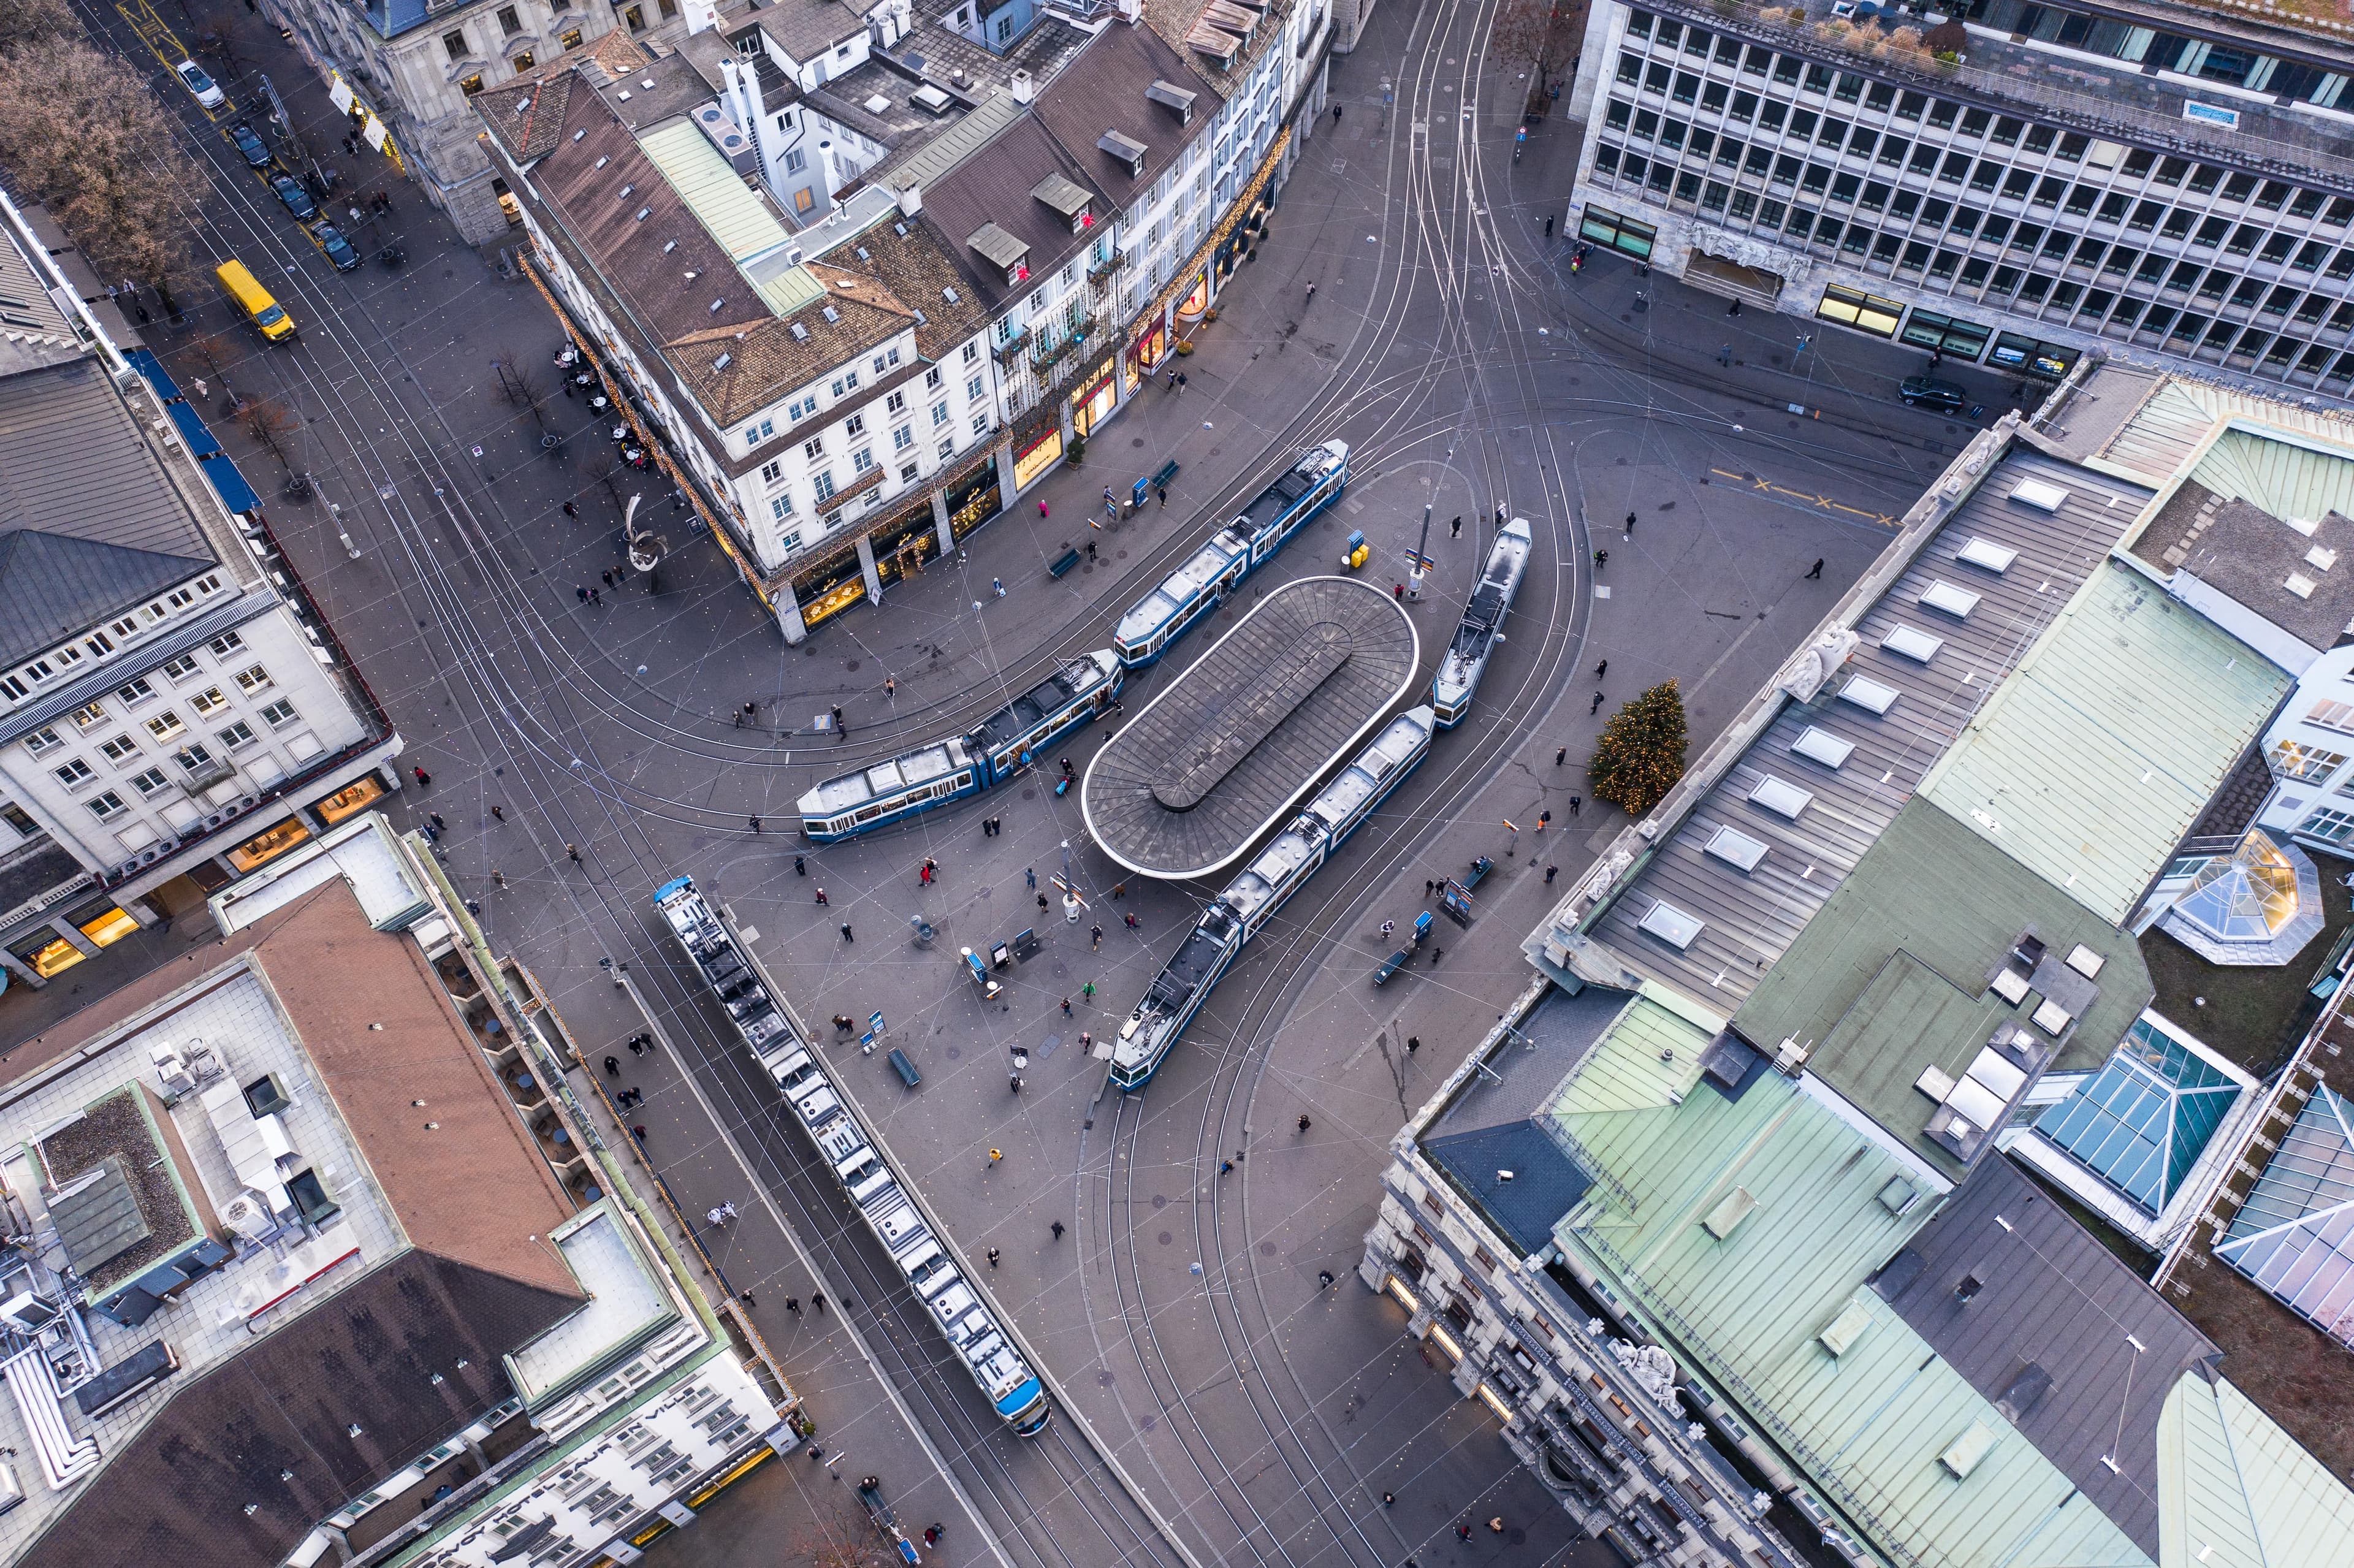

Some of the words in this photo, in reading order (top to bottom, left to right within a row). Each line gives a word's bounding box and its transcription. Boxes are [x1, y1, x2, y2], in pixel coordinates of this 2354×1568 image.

[422, 1525, 485, 1568] SAVOY
[493, 1483, 557, 1524] HOTEL
[559, 1443, 612, 1480] BAUR
[617, 1422, 643, 1441] EN
[645, 1387, 695, 1420] VILLE
